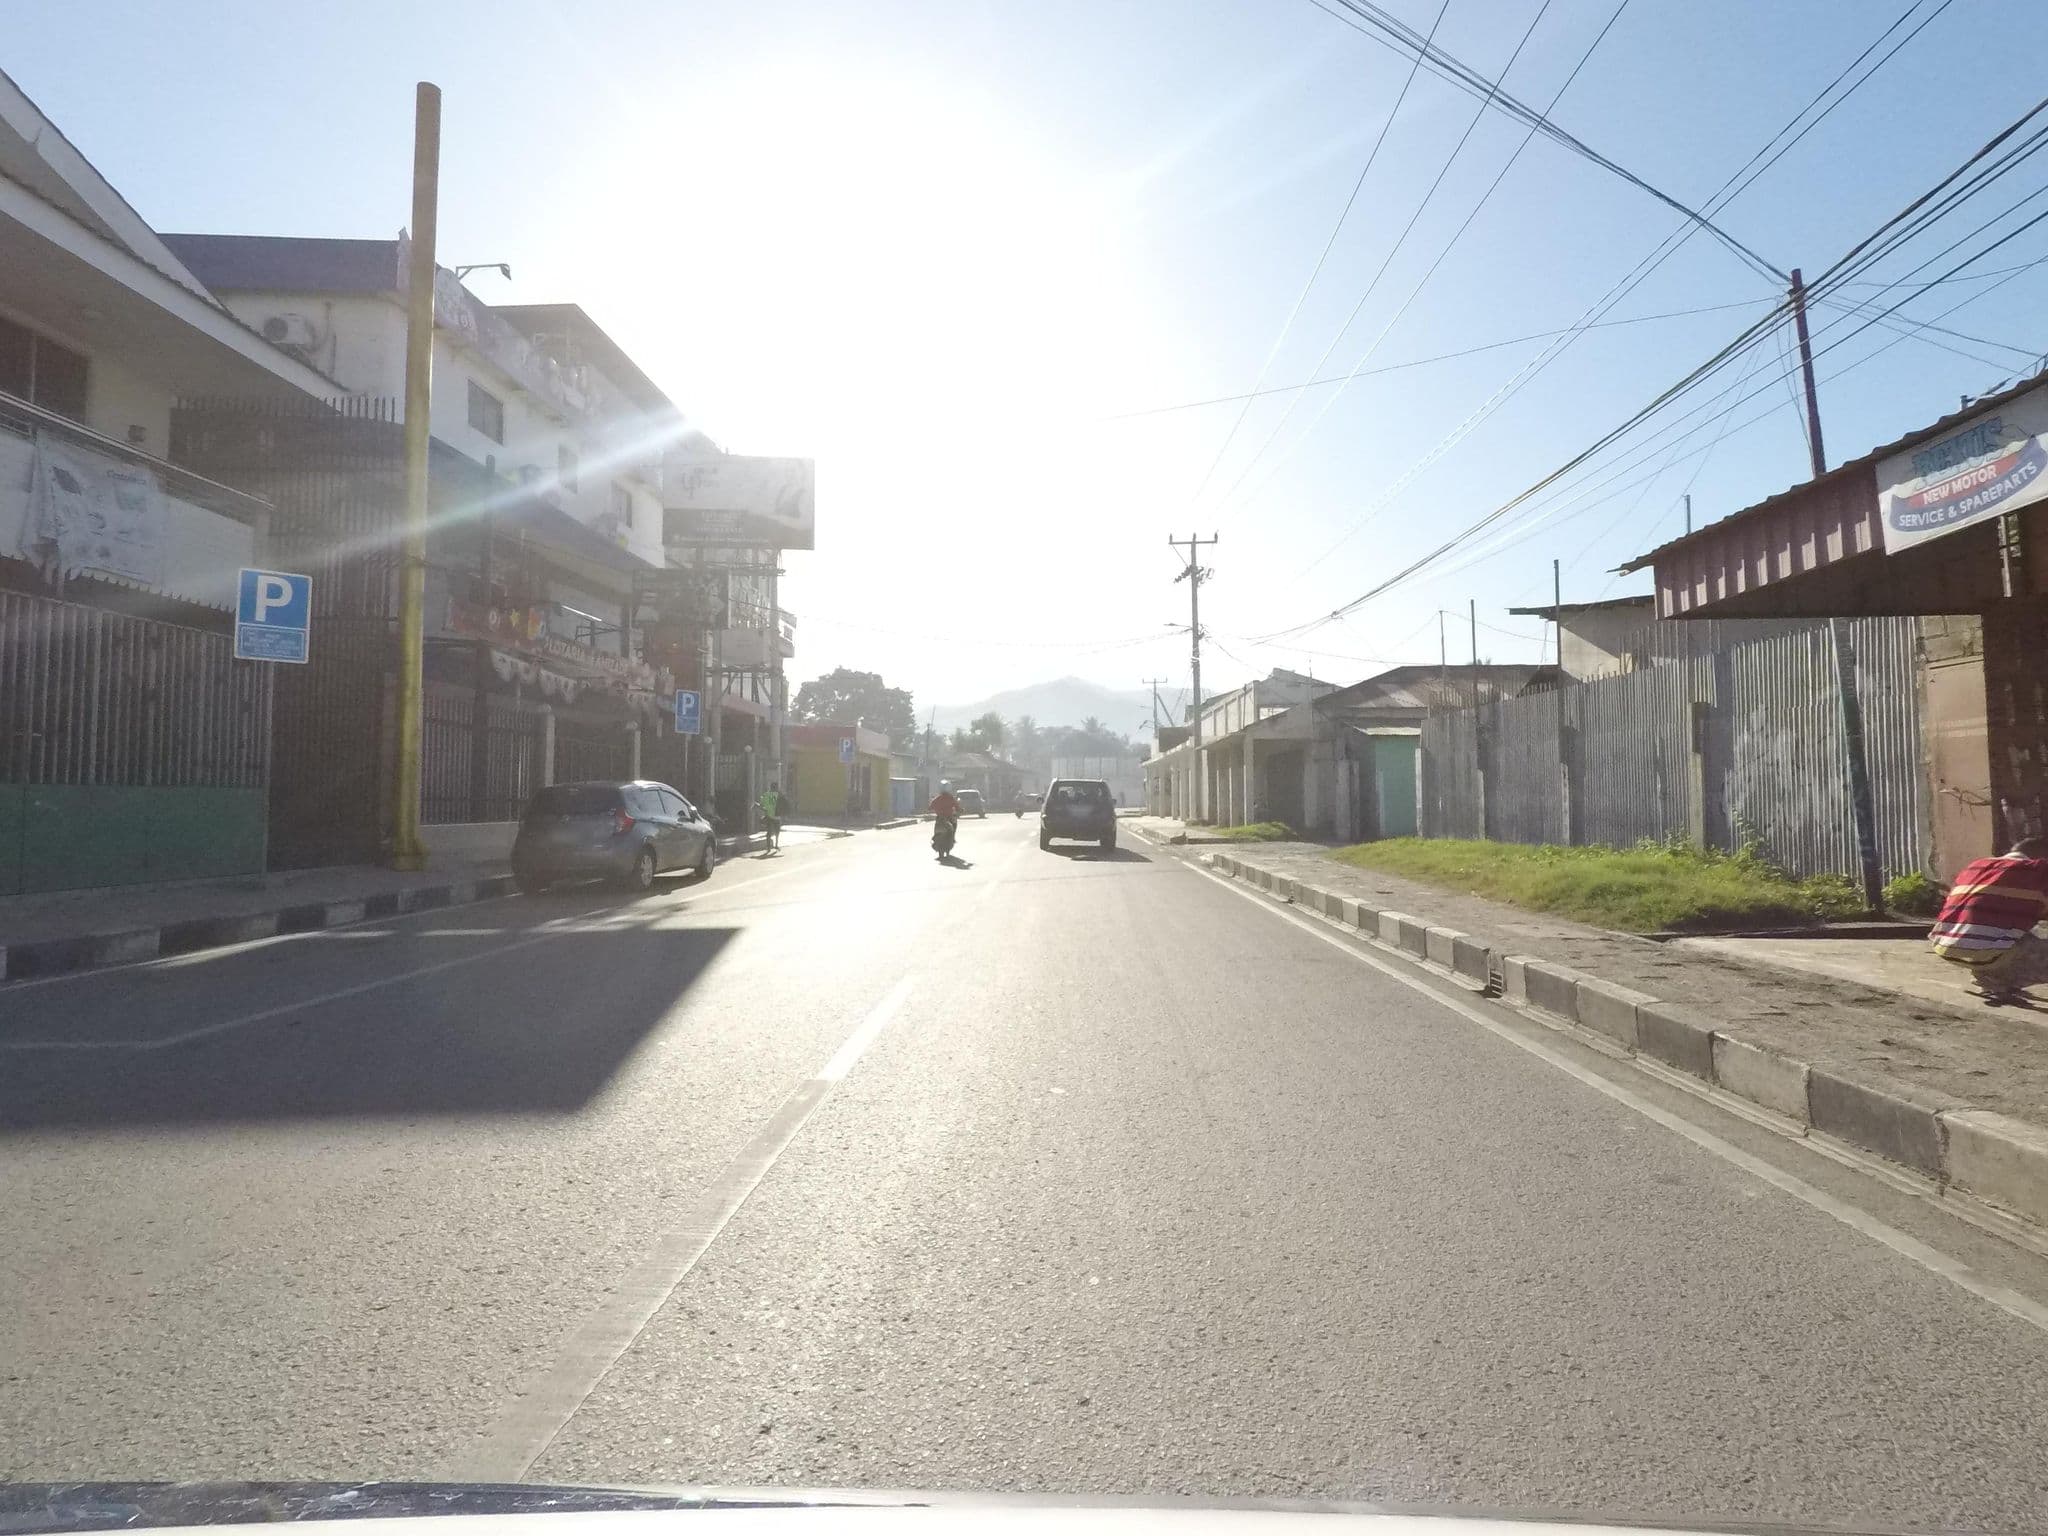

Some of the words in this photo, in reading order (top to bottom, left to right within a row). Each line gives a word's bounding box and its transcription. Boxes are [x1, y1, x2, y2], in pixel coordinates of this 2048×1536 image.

[1899, 508, 1945, 526] SERVICE
[1948, 504, 1957, 518] &
[1960, 461, 2038, 514] SPAREPARTS
[1923, 485, 1950, 504] NEW
[1951, 464, 1998, 494] MOTOR
[256, 575, 293, 621] P
[682, 693, 695, 715] P
[843, 739, 851, 752] P
